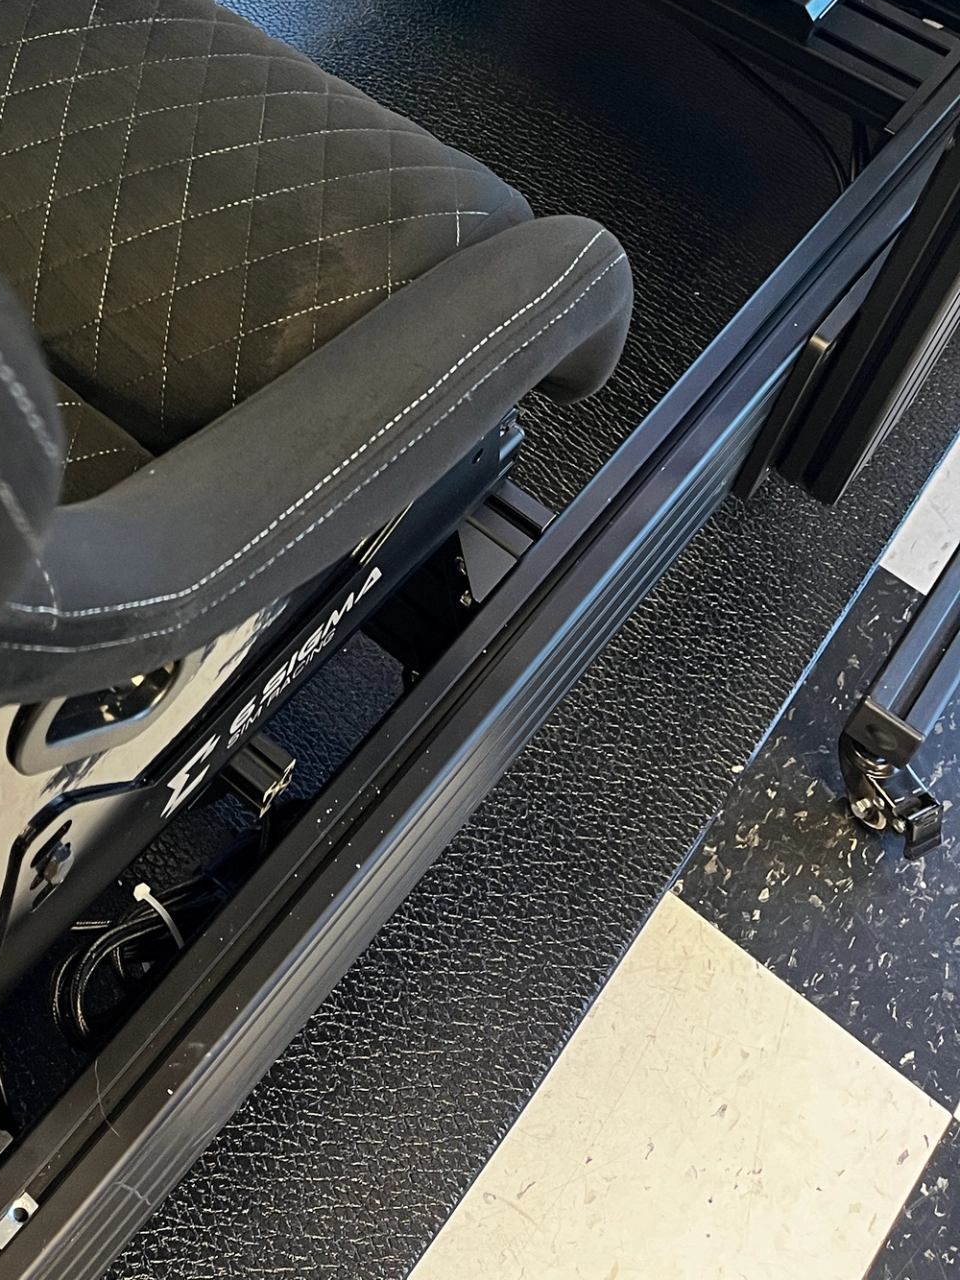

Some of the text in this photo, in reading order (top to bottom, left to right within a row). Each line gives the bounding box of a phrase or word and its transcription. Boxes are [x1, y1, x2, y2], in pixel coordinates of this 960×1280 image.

[226, 627, 337, 749] SIM RACING
[259, 566, 383, 705] SIGMA
